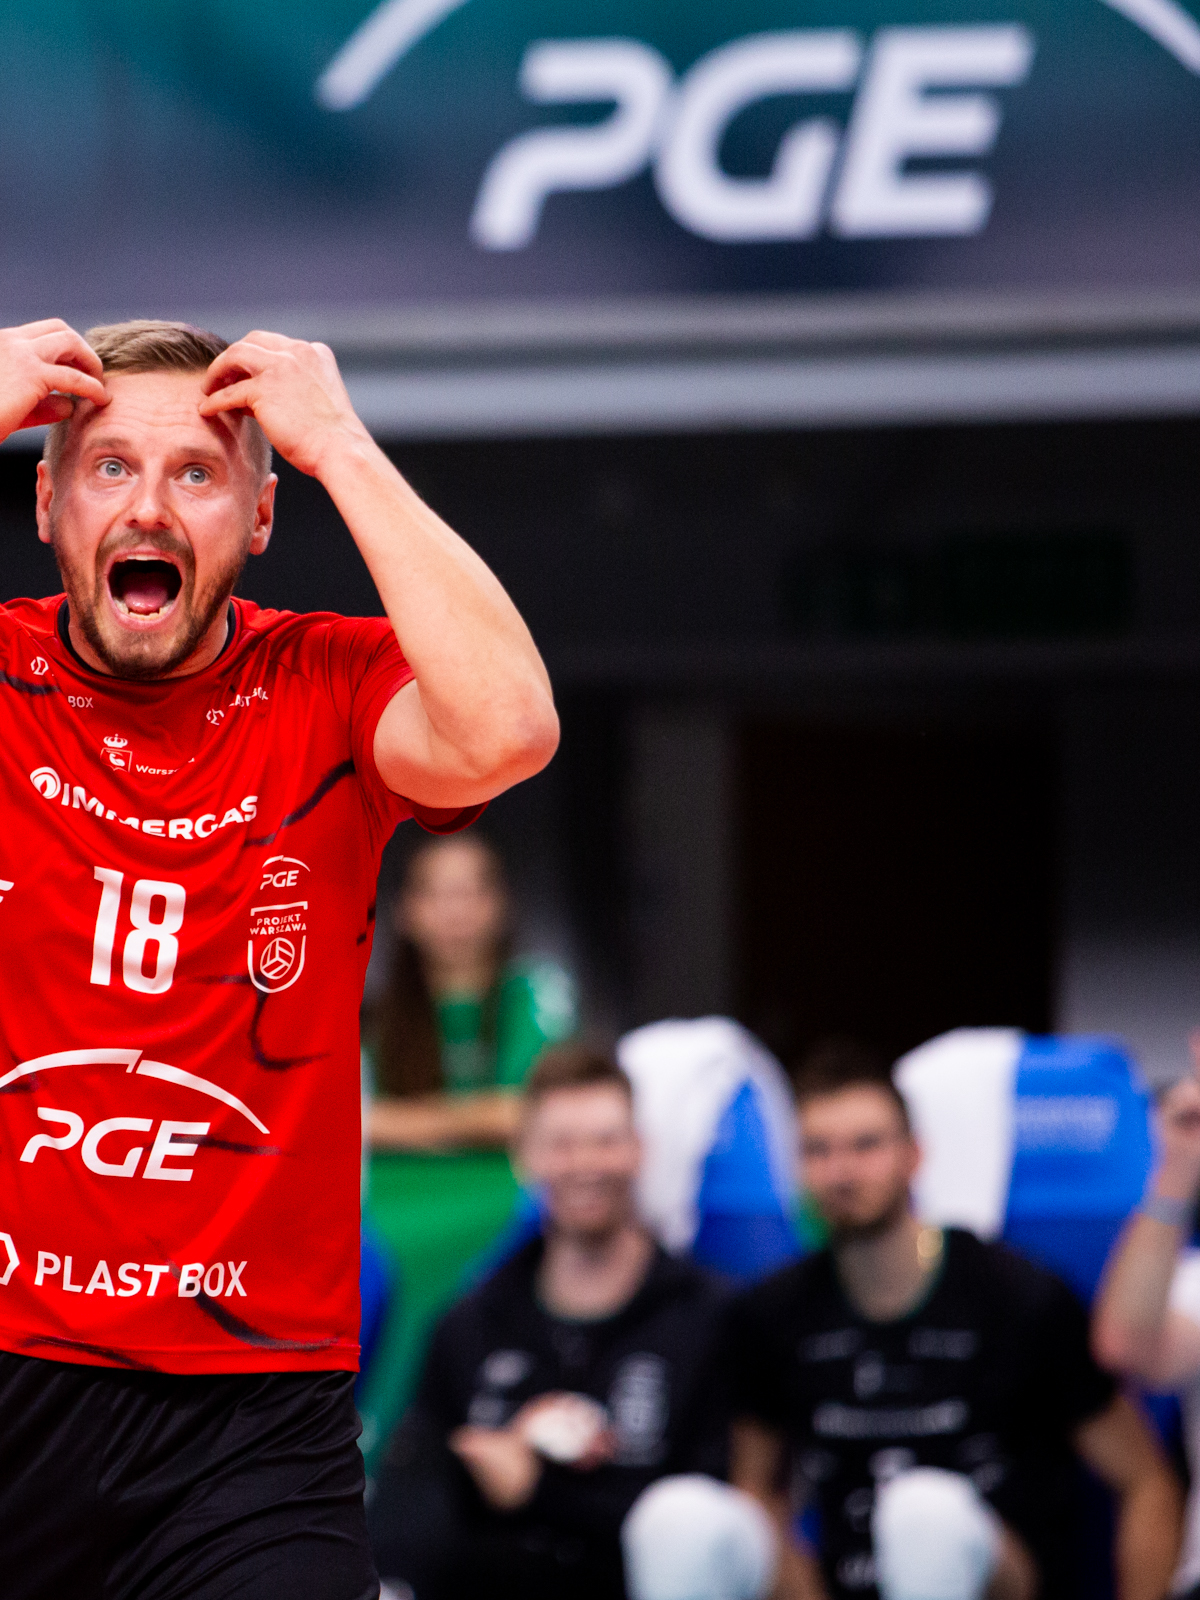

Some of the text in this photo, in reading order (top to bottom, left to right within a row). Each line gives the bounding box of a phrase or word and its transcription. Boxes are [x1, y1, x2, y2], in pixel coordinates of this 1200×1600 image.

[471, 25, 1034, 250] PGE
[67, 695, 94, 709] BOX
[135, 762, 186, 776] Warsz
[61, 783, 258, 840] IMMERGAS
[260, 869, 299, 890] PGE
[90, 866, 186, 994] 18
[250, 923, 307, 935] WARSZAWA
[256, 913, 301, 926] PROJEKT
[19, 1107, 210, 1181] PGE
[34, 1250, 248, 1298] PLAST BOX
